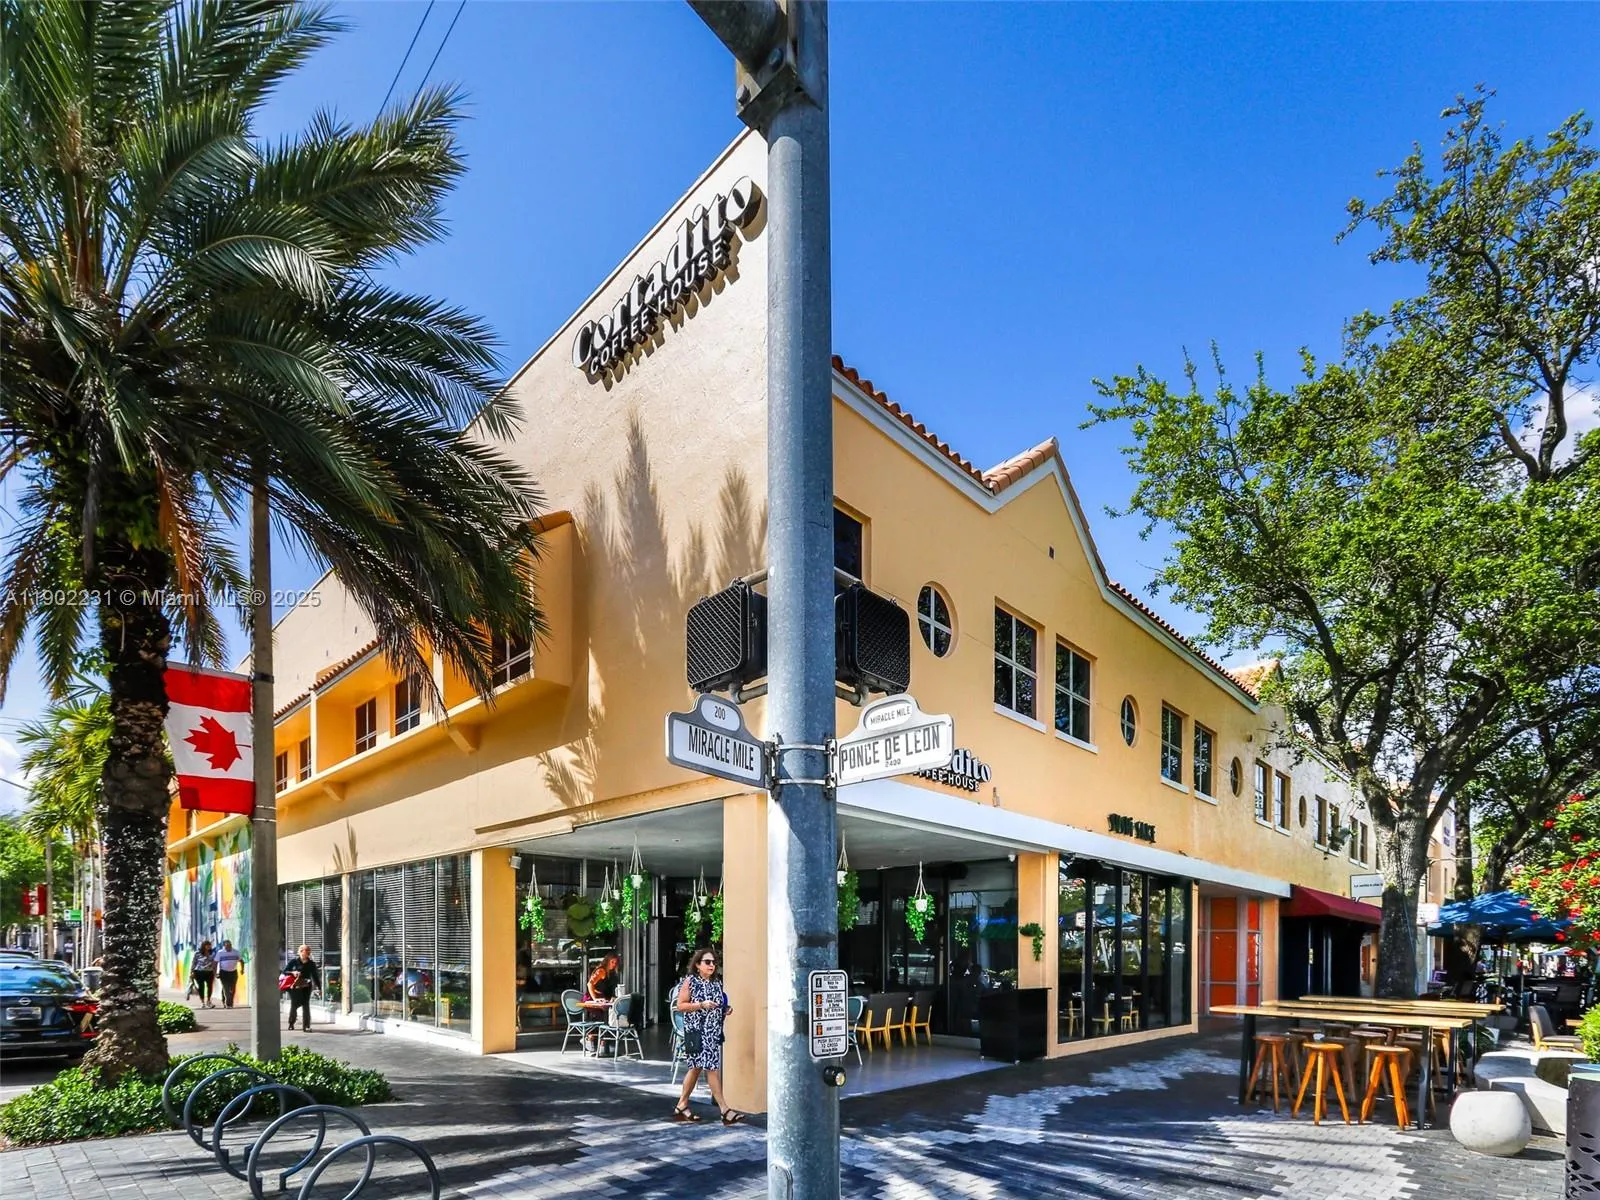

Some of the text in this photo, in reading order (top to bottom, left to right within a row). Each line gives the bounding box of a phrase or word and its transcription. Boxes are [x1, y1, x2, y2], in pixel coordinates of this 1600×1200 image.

[590, 239, 725, 376] COFFEE HOUSE
[714, 705, 726, 721] 200
[870, 705, 911, 726] MIRACLE MILE
[688, 725, 754, 771] MIRACLE MILE
[840, 724, 941, 772] PONCE DE LEON
[884, 758, 902, 768] 2400
[947, 772, 981, 792] HOUSE
